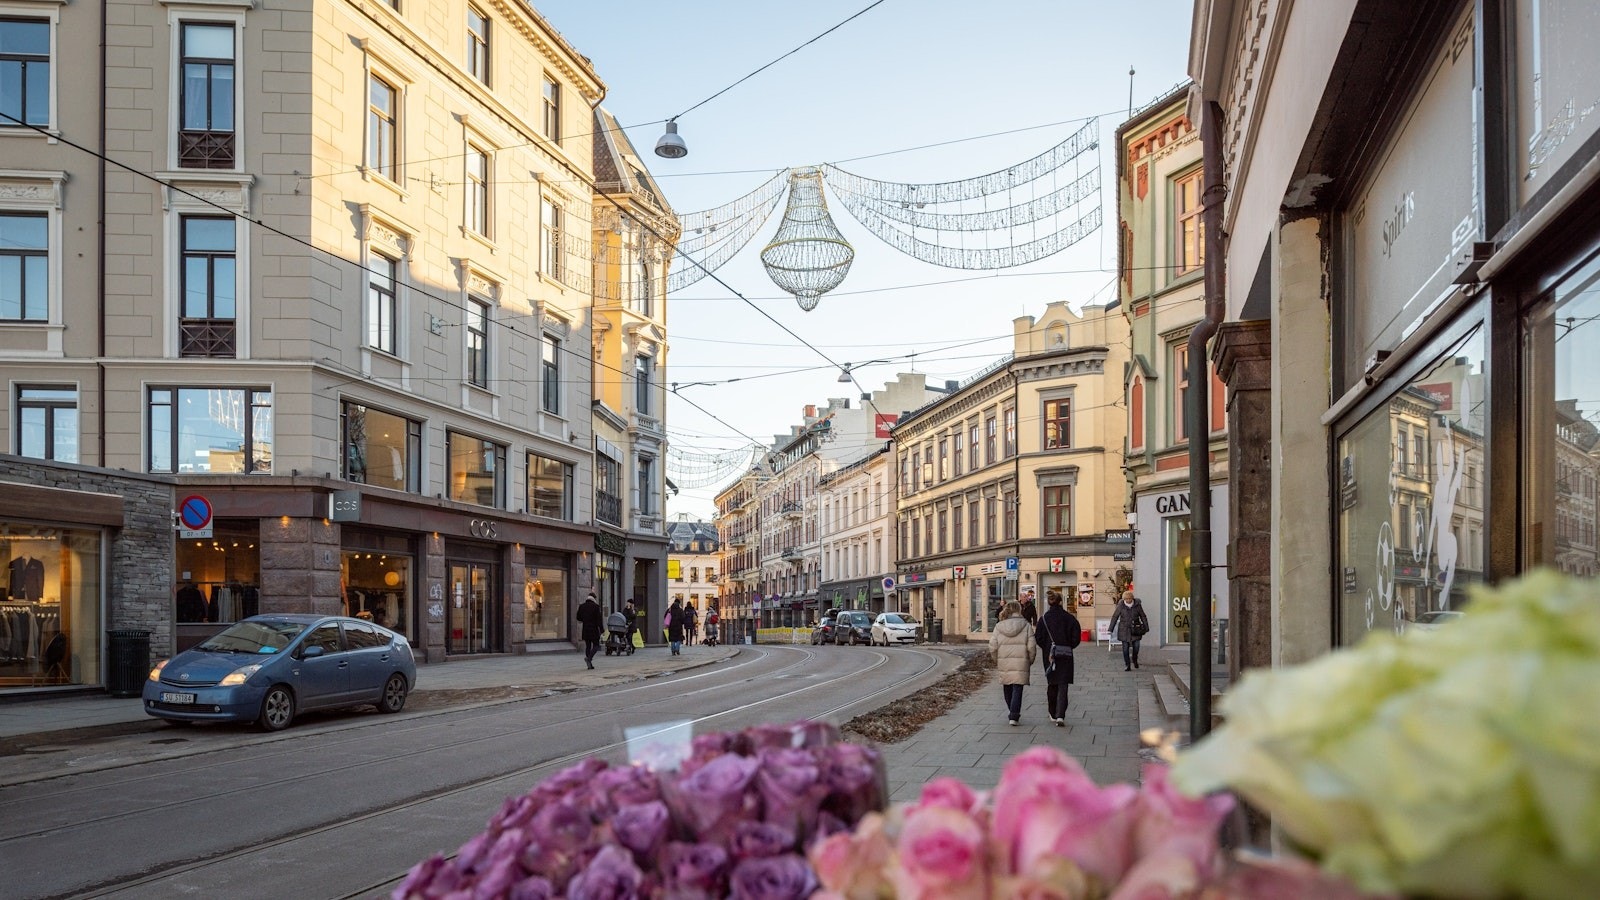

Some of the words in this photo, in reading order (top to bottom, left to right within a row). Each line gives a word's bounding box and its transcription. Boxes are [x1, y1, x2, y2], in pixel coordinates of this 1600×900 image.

[1383, 191, 1415, 259] Spirits
[336, 501, 357, 511] COS
[1156, 490, 1213, 514] GANI
[470, 519, 497, 539] COS
[1008, 559, 1016, 569] P
[165, 693, 173, 702] SU
